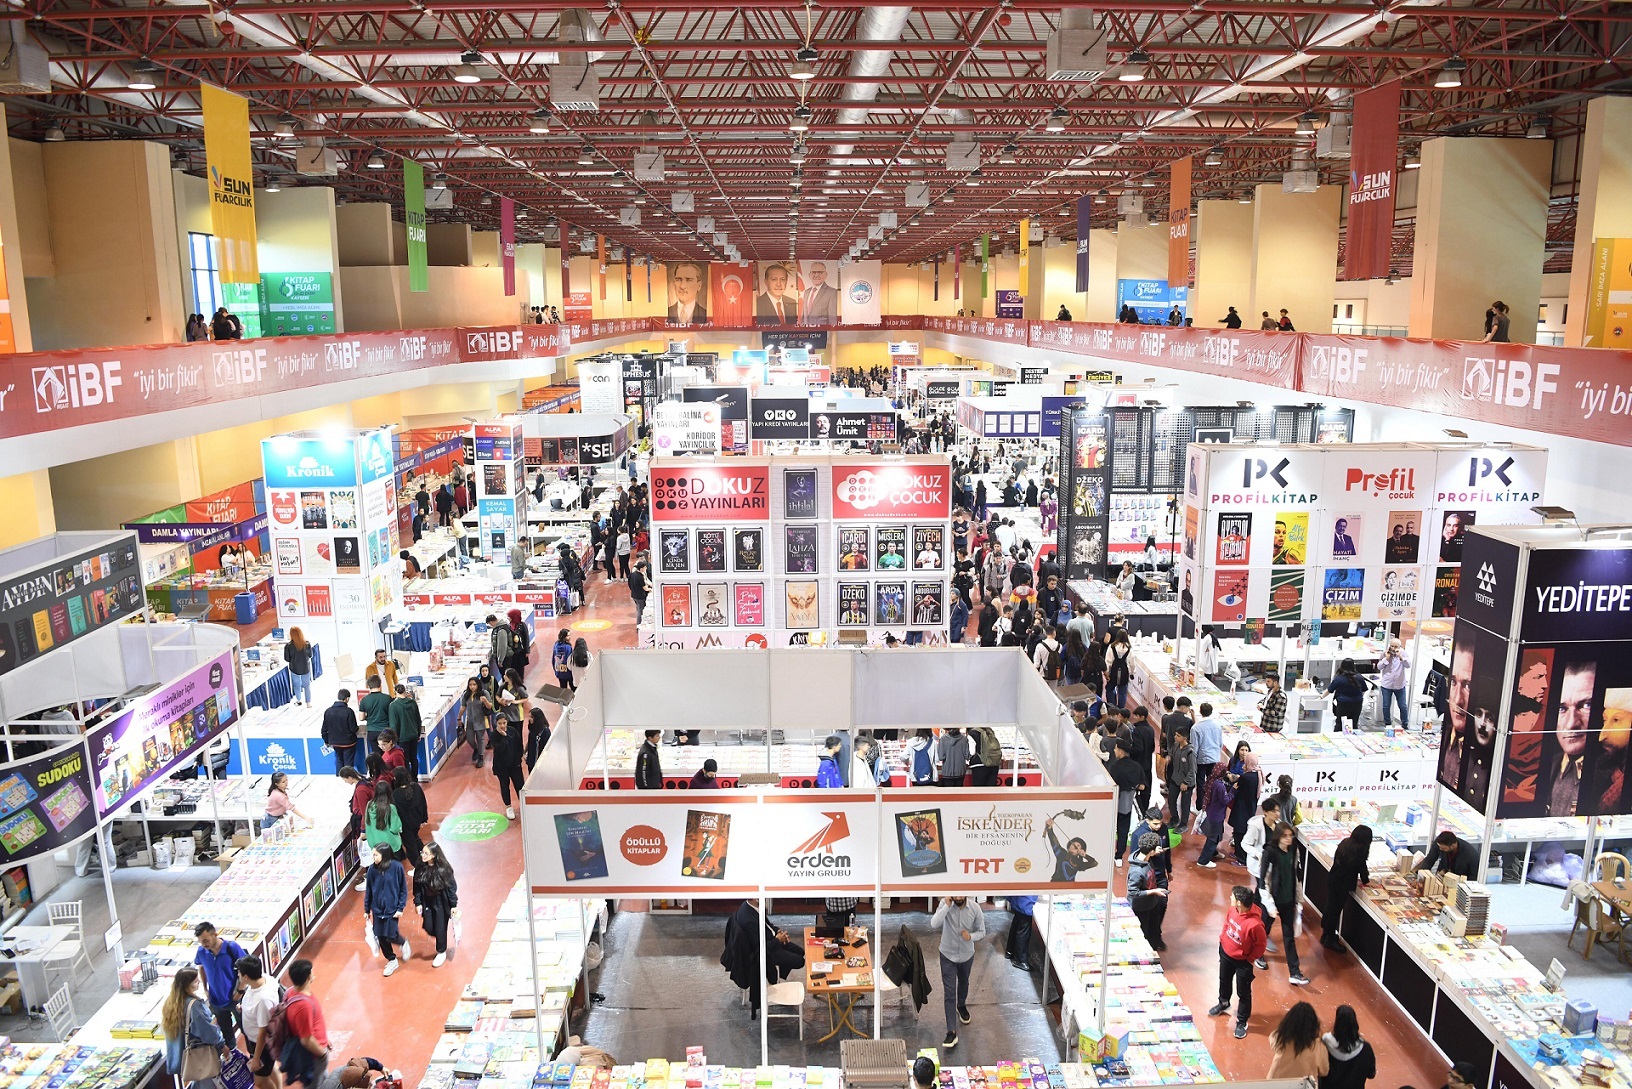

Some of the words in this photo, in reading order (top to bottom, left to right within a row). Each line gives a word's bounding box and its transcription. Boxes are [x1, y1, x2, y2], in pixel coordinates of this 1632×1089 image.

[224, 178, 251, 194] SUN
[1362, 171, 1391, 190] SUN
[1169, 224, 1188, 239] FUARI
[1601, 247, 1610, 272] ALANI
[158, 372, 175, 390] bir
[1397, 365, 1413, 385] bir
[765, 410, 797, 420] YKY
[836, 417, 866, 426] Ahmet
[686, 431, 716, 440] KORİDOR
[836, 426, 858, 436] Ümit
[679, 440, 716, 449] YAYINCILIK
[286, 465, 335, 477] Kronik
[691, 477, 765, 495] DOKUZ
[1345, 468, 1415, 497] Profil
[889, 491, 942, 507] ÇOCUK
[1211, 490, 1318, 505] PROFİLKİTAP
[1388, 489, 1415, 500] çocuk
[1438, 489, 1540, 503] PROFİLKİTAP
[207, 496, 231, 516] KİTAP
[690, 497, 765, 508] YAYINLARI
[152, 529, 178, 537] DAMLA
[842, 532, 866, 543] ICARDI
[878, 532, 904, 541] MUSLERA
[1, 573, 53, 612] AYDIN
[1325, 590, 1360, 601] ÇİZİM
[1381, 592, 1417, 603] ÇİZİMDE
[1536, 580, 1632, 613] YEDİTEPE
[1475, 593, 1495, 608] YEDİTEPE
[1301, 624, 1321, 632] MESSI
[161, 689, 184, 709] minikler
[184, 681, 196, 698] için
[150, 713, 171, 731] okuma
[170, 697, 195, 720] kitapları
[259, 753, 297, 765] Kronik
[37, 757, 82, 788] SUDOKU
[272, 763, 297, 771] Çocuk
[46, 782, 75, 810] SUDOKU
[957, 816, 1033, 831] İSKENDER
[626, 836, 661, 846] ÖDÜLLÜ
[980, 839, 1012, 847] DOĞUŞU
[787, 853, 851, 868] erdem
[960, 858, 1004, 874] TRT
